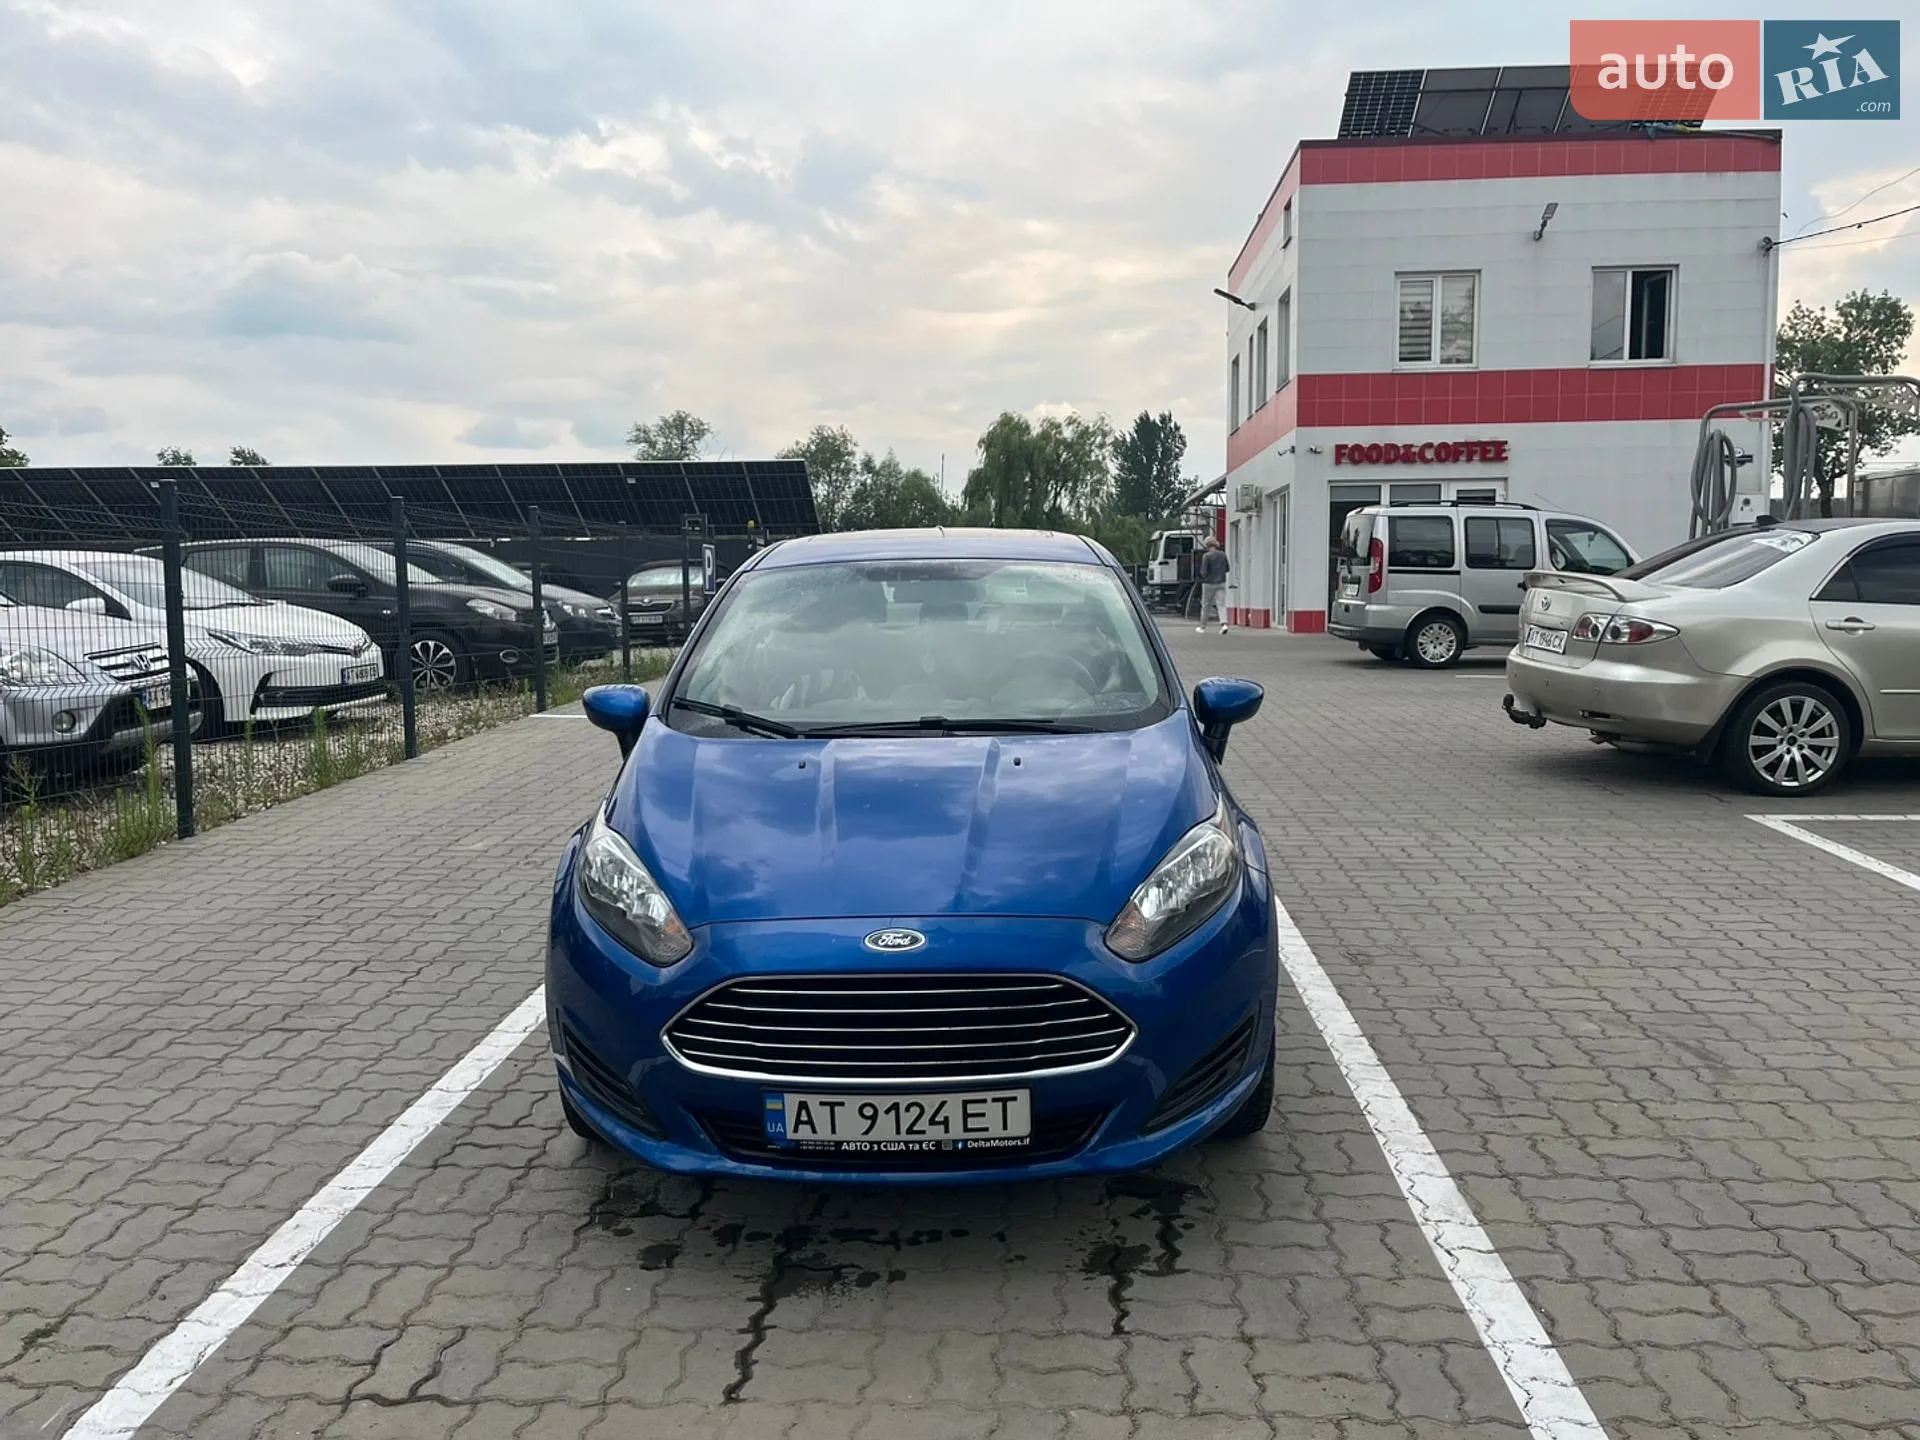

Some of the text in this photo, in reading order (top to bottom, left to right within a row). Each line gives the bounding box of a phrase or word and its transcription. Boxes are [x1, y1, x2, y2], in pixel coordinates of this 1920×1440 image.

[1335, 440, 1508, 465] FOOD&COFFEE
[878, 933, 911, 946] Ford
[792, 1096, 1018, 1136] AT 9124 ET
[767, 1122, 784, 1133] UA
[841, 1142, 870, 1151] АВТО
[880, 1142, 906, 1151] США
[908, 1143, 920, 1151] та
